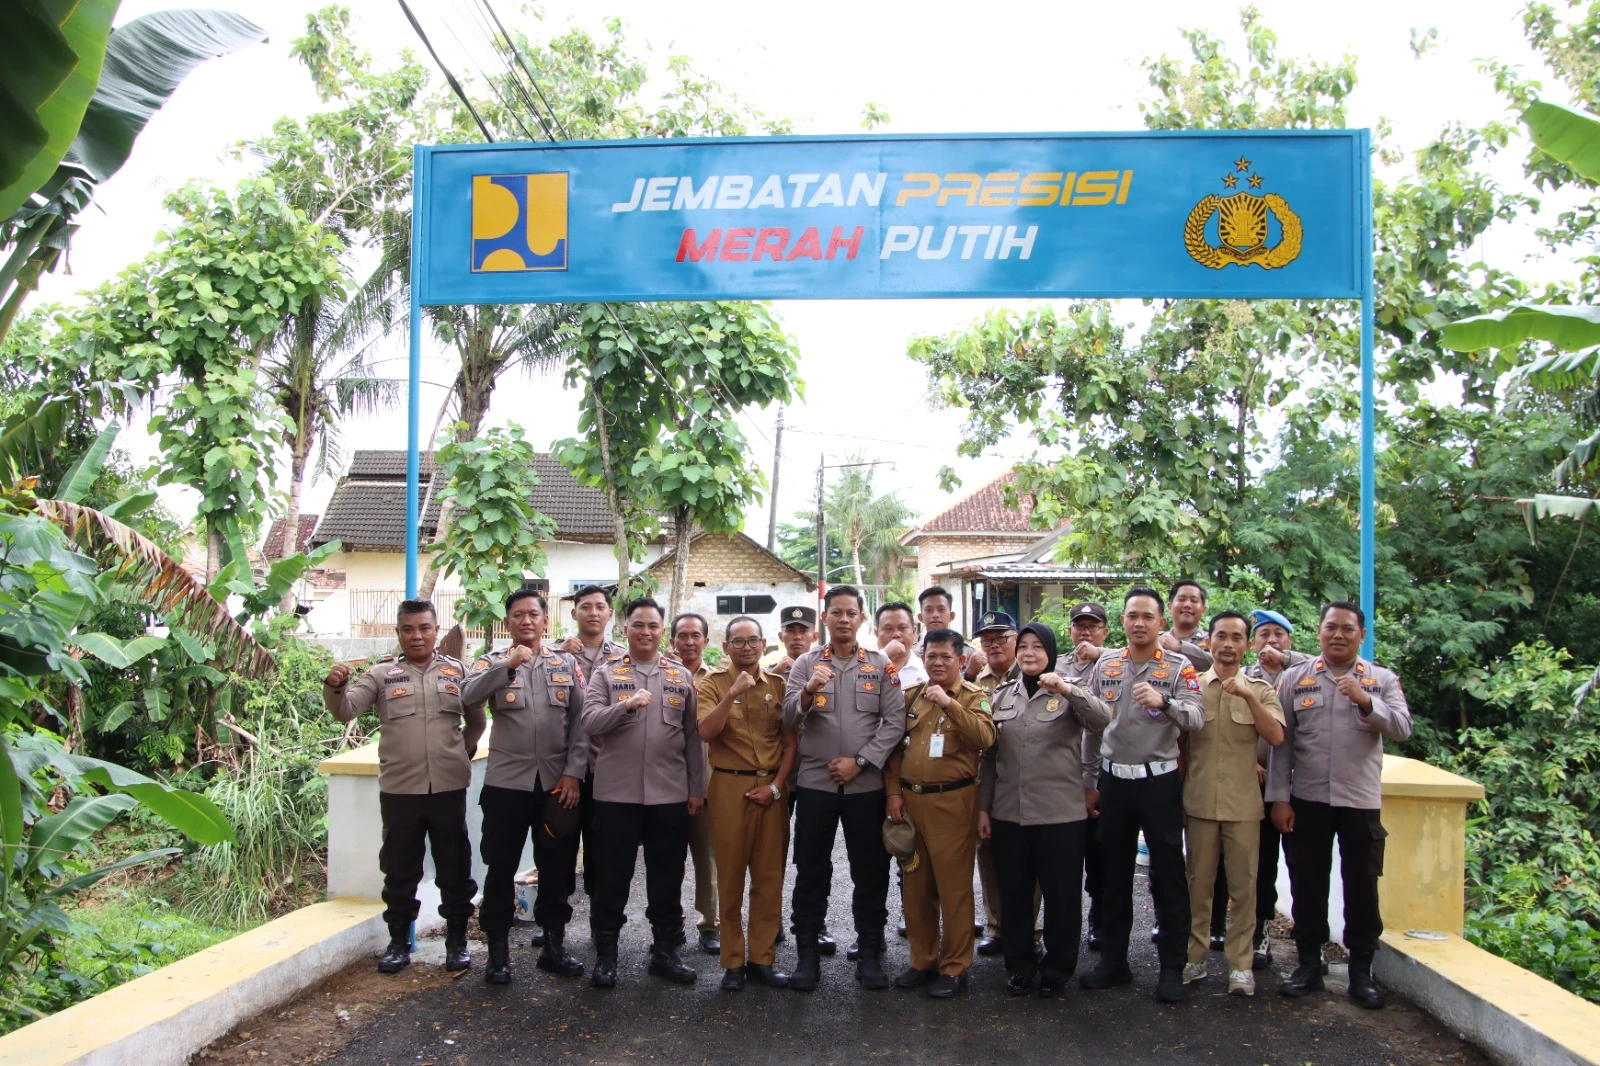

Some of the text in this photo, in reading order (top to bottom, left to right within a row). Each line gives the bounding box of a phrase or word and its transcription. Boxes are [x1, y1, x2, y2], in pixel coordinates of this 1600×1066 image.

[611, 169, 1134, 213] JEMBATAN PRESISI
[675, 225, 1039, 263] MERAH PUTIH
[437, 675, 461, 684] POLRI
[1147, 680, 1171, 688] POLRI
[612, 683, 636, 691] HARIS
[663, 685, 685, 695] POLRI
